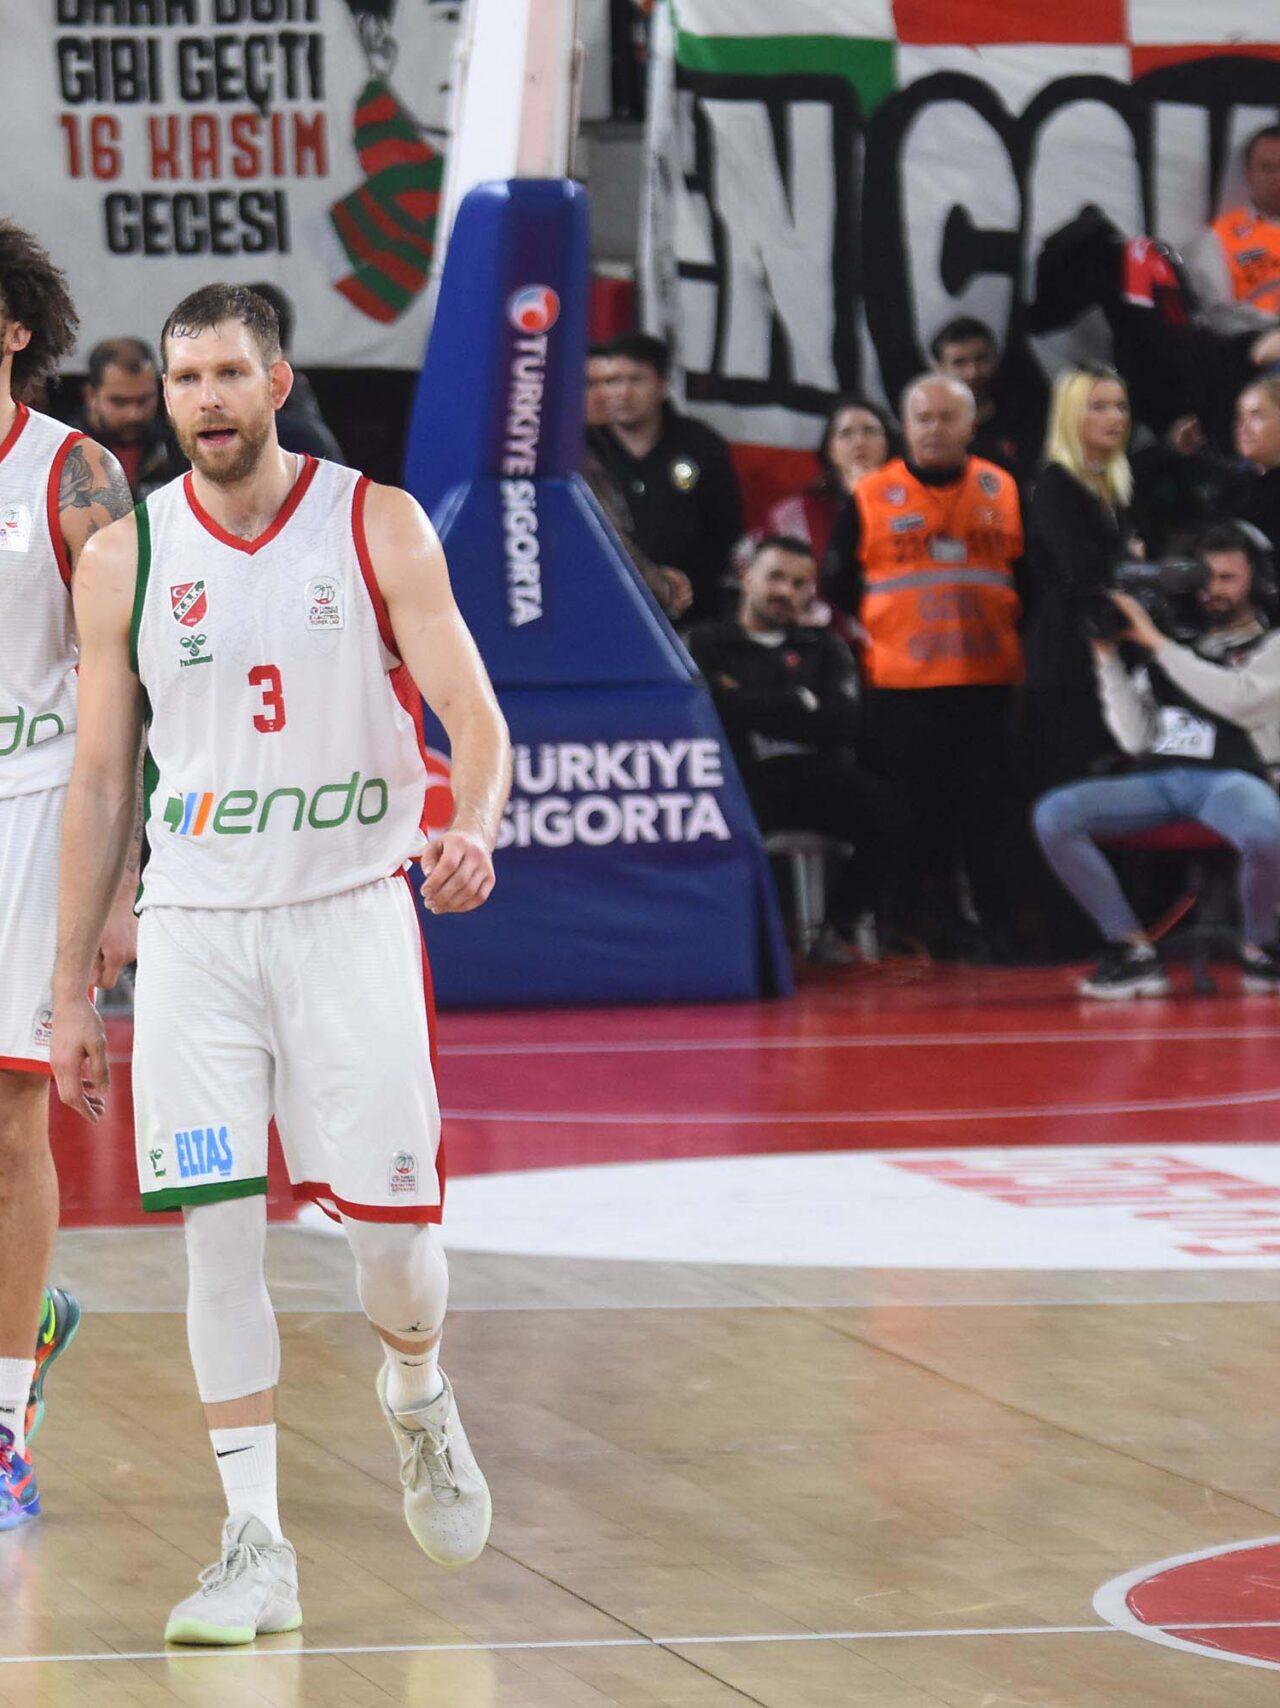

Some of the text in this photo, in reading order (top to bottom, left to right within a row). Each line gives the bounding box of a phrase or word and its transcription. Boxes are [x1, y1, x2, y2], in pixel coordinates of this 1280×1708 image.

[59, 113, 121, 180] 16
[180, 653, 214, 667] hummel
[248, 664, 286, 733] 3
[213, 771, 388, 834] endo
